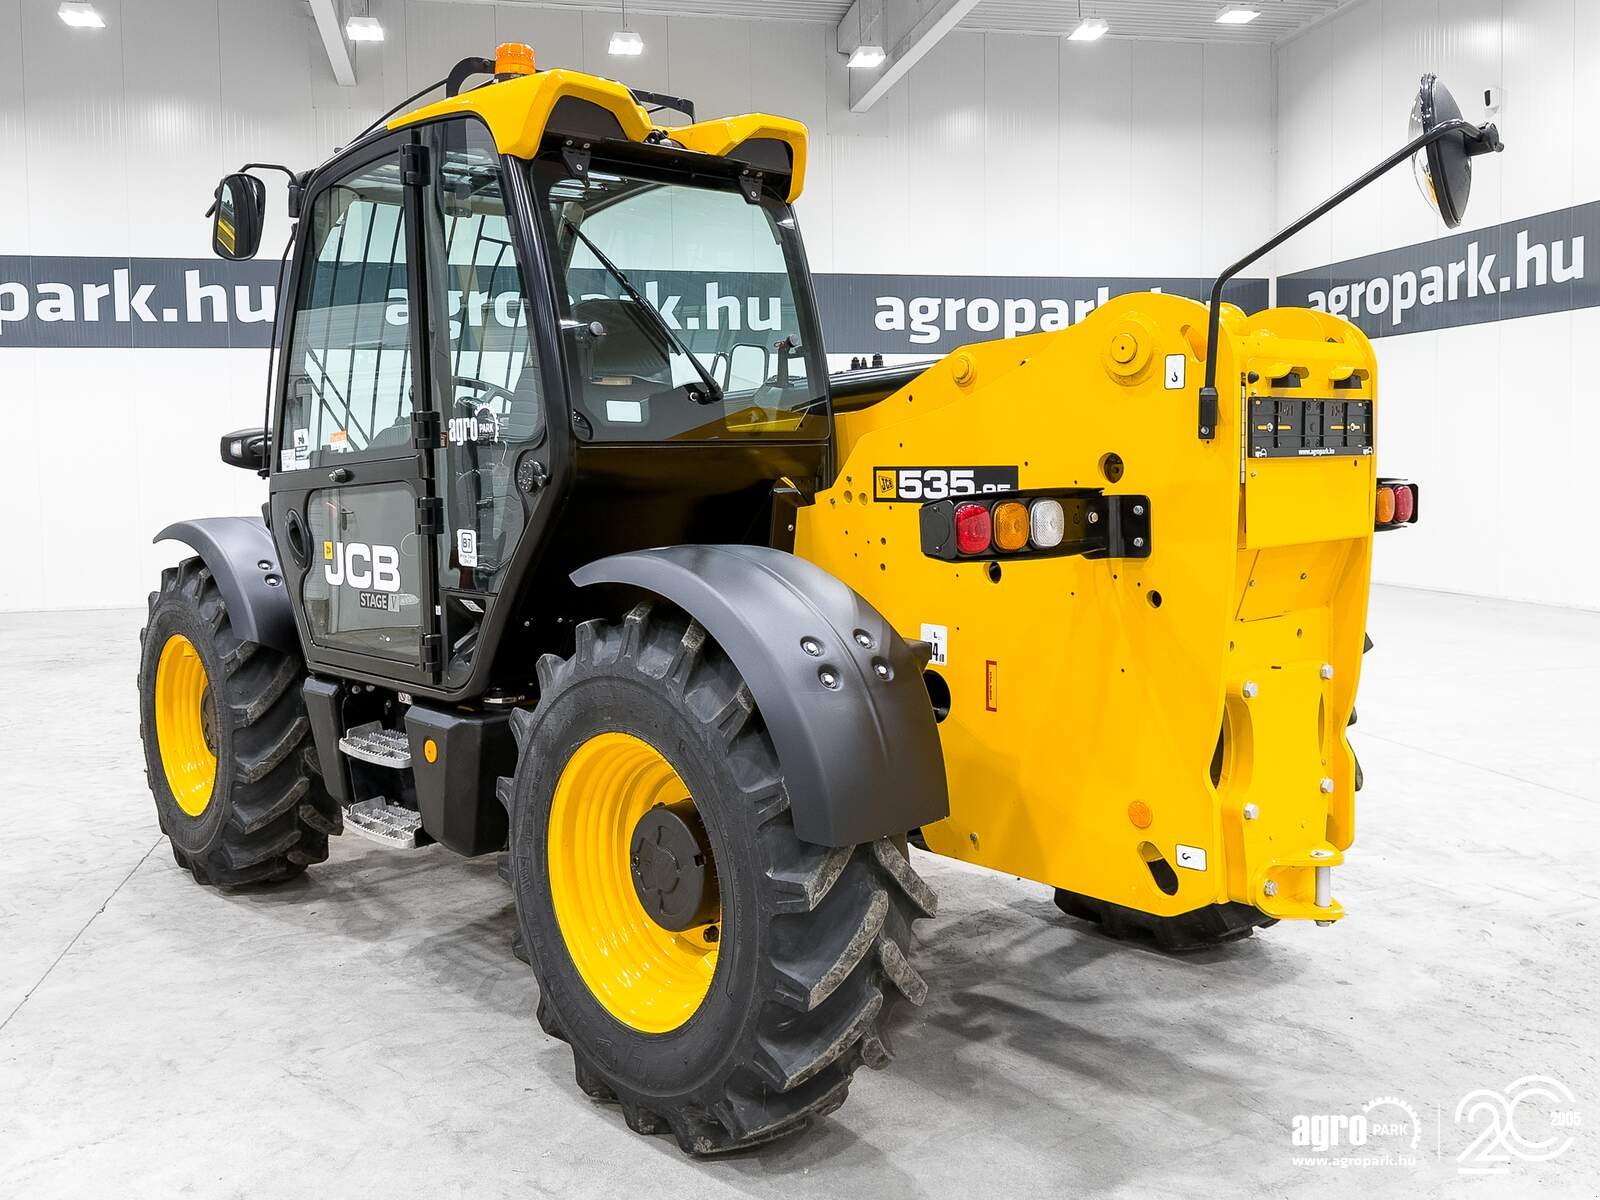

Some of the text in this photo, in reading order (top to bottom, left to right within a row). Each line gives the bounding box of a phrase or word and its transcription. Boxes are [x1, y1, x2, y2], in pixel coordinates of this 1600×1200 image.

[1308, 230, 1585, 326] agropark.hu
[448, 416, 478, 446] agro
[478, 423, 495, 433] PARK
[324, 541, 401, 593] JCB
[360, 592, 388, 609] STAGE
